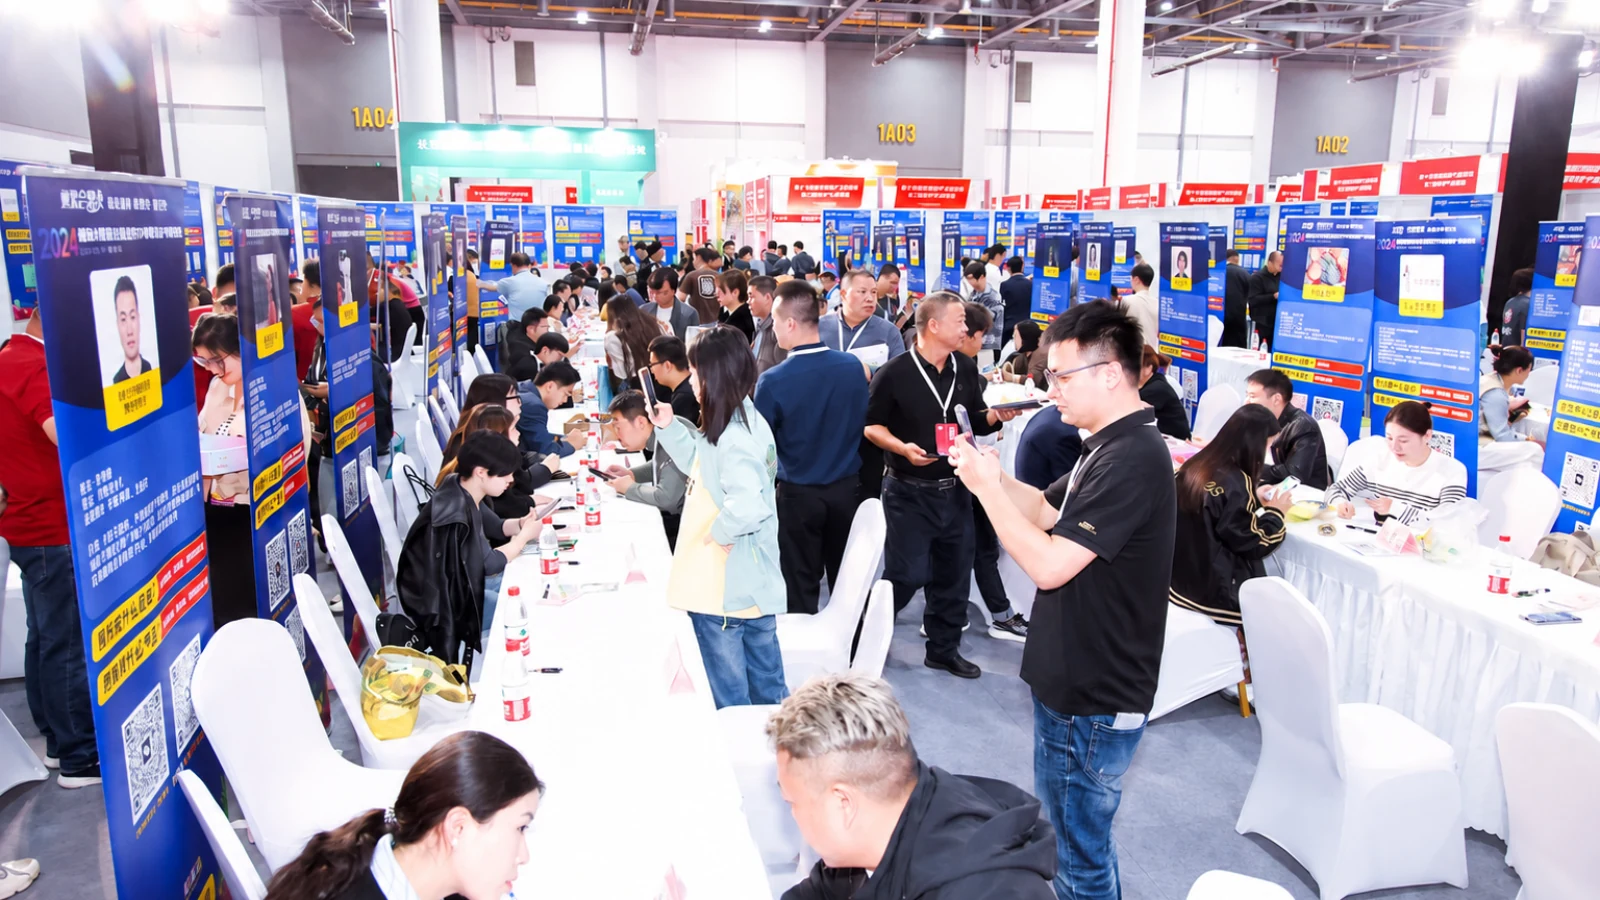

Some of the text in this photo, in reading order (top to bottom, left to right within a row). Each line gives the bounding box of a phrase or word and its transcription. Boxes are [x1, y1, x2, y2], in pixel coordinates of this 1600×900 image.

[877, 123, 917, 143] 1A03
[1316, 135, 1350, 153] 1A02
[37, 227, 79, 259] 2024
[1376, 238, 1396, 250] 2024
